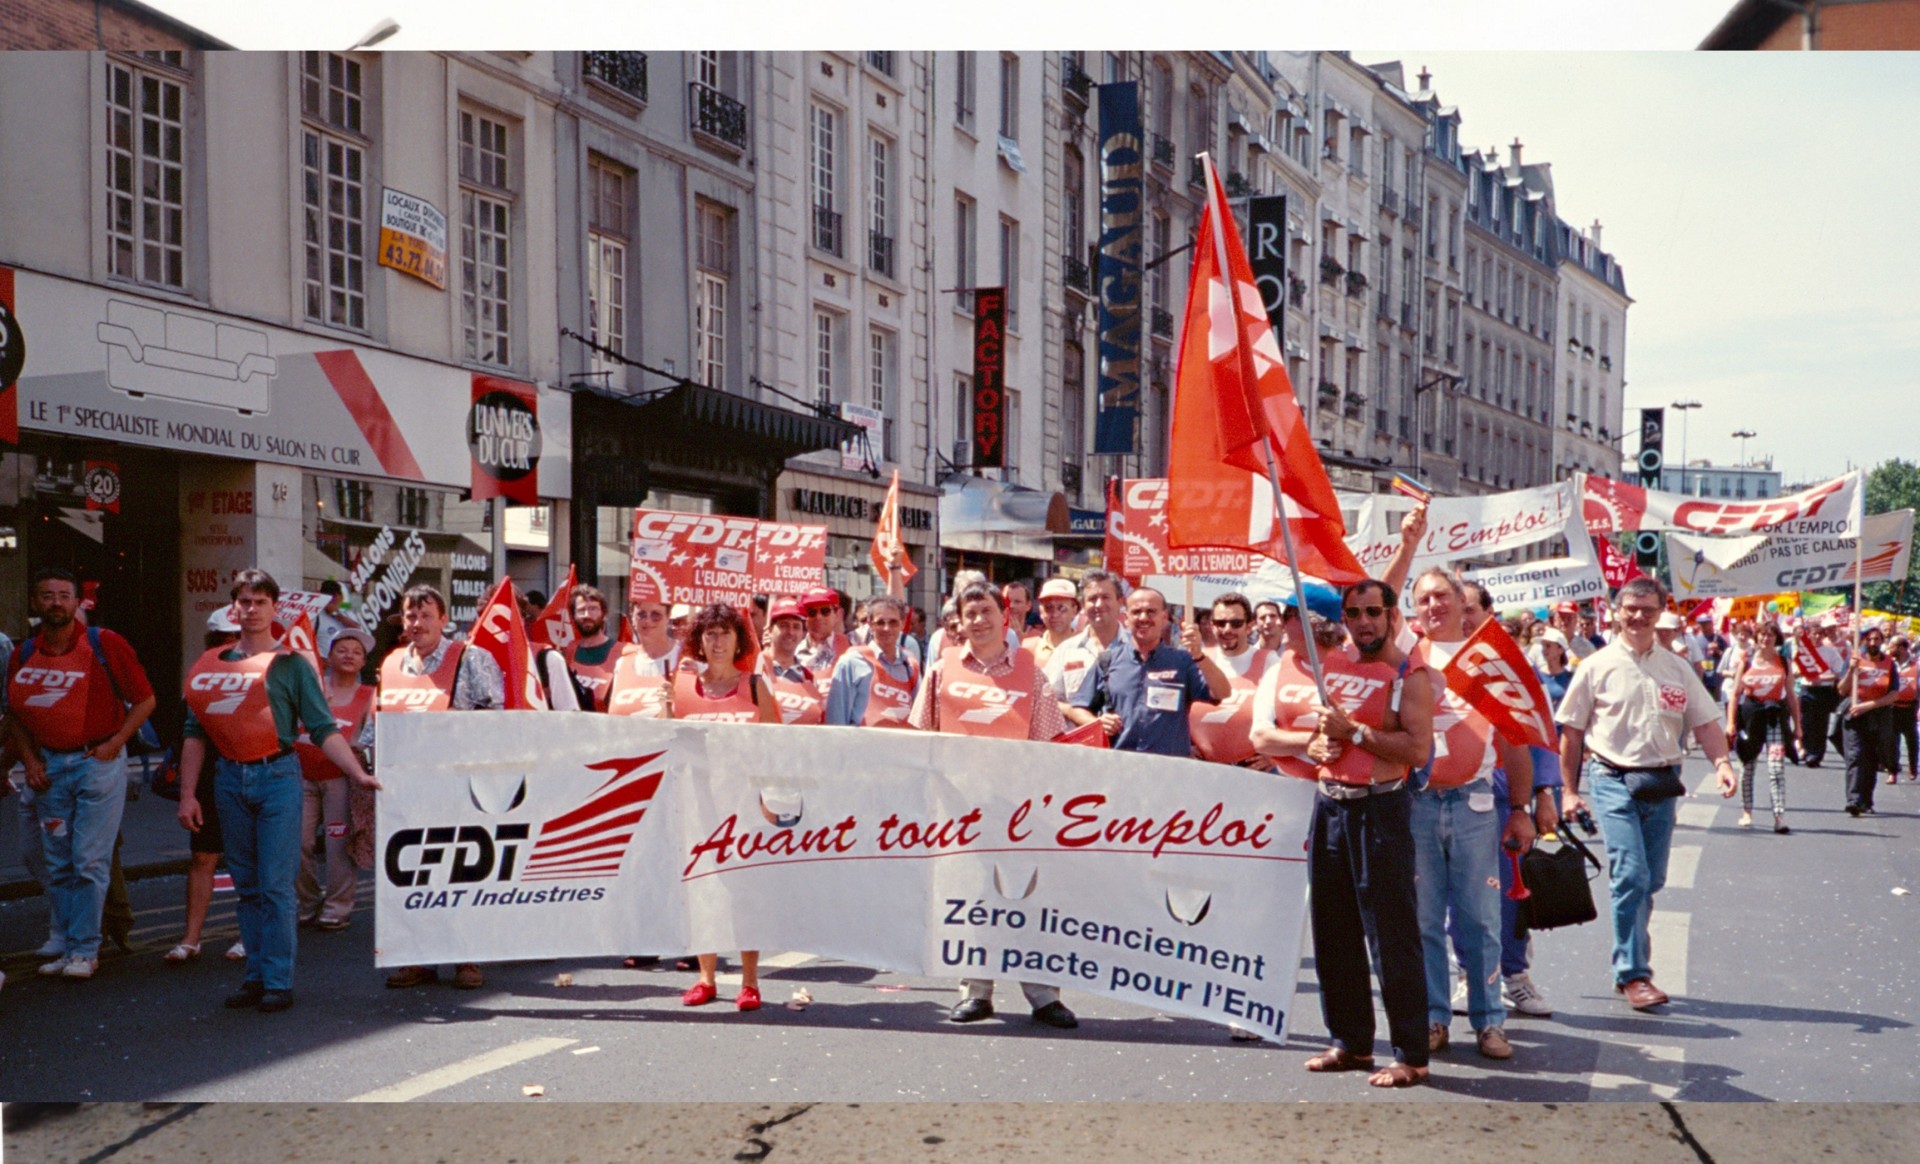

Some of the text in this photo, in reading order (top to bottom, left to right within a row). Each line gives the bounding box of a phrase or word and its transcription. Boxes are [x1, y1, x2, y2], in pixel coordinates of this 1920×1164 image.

[387, 193, 420, 214] LOCAUX
[1100, 132, 1144, 413] MAGAUD
[976, 295, 1000, 457] FACTORY
[30, 401, 47, 421] LE
[75, 407, 160, 438] SPECIALISTE
[166, 421, 236, 448] MONDIAL
[241, 432, 261, 451] DU
[266, 435, 306, 458] SALON
[311, 444, 326, 461] EN
[331, 447, 360, 466] CUIR
[475, 403, 533, 441] L'UNIVERS
[479, 435, 530, 470] DU CUIR
[94, 474, 113, 496] 20
[211, 491, 252, 514] ETAGE
[797, 488, 868, 519] MAURICE
[1673, 480, 1844, 535] CFDT
[638, 513, 755, 547] CFDT
[756, 523, 826, 547] FDT
[1426, 506, 1547, 552] l'Emploi
[1788, 520, 1852, 534] L'EMPLOI
[351, 524, 395, 592] SALONS
[1771, 545, 1791, 559] PAS
[1795, 544, 1810, 556] DE
[1813, 538, 1858, 554] CALAIS
[450, 554, 487, 571] SALONS
[774, 565, 821, 580] L'EUROPE
[1168, 554, 1200, 572] POUR
[1202, 554, 1249, 572] L'EMPLOI
[187, 568, 217, 593] SOUS
[355, 528, 425, 636] ISPONIBLES
[695, 569, 752, 590] L'EUROPE
[759, 578, 783, 592] POUR
[1191, 572, 1248, 588] ndustries
[1476, 567, 1560, 588] nciement
[1776, 562, 1847, 588] CFDT
[279, 591, 320, 603] DT
[452, 579, 485, 596] TABLES
[674, 586, 704, 604] POUR
[1490, 578, 1603, 604] our l'Emploi
[15, 667, 86, 686] CFDT
[190, 672, 262, 691] CFDT
[1324, 672, 1385, 699] CFDT
[1743, 674, 1782, 686] CFDT
[380, 688, 447, 706] CFDT
[615, 687, 661, 705] CFD
[775, 691, 819, 711] FDT
[873, 683, 913, 702] CFD
[948, 681, 1028, 705] CFDT
[1279, 684, 1321, 705] CF
[1456, 642, 1551, 747] CFDT
[683, 793, 1276, 877] Avant tout l'Emploi
[384, 823, 531, 888] CFDT
[404, 886, 606, 910] GIAT Industries
[944, 898, 1266, 981] Zéro licenciement
[942, 939, 988, 967] Un
[1001, 947, 1099, 981] pacte
[1110, 966, 1192, 1001] pour
